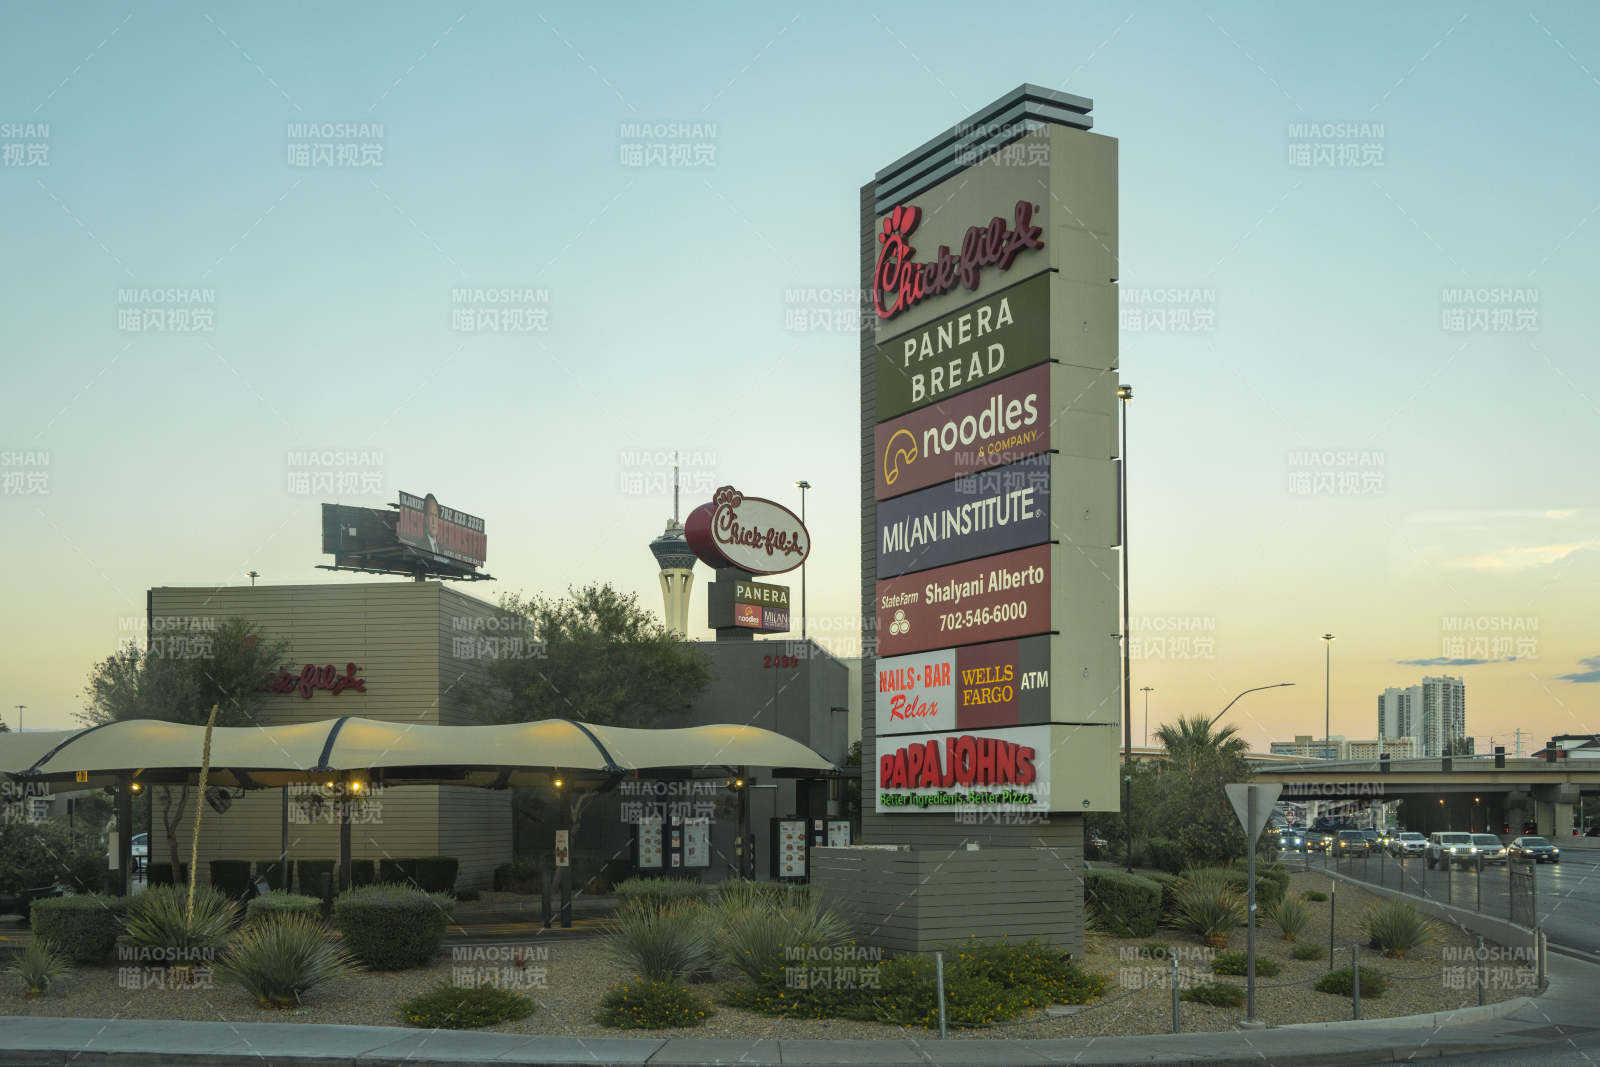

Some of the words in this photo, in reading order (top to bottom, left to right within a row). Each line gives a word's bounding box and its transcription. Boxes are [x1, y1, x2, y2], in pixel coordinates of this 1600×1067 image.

[873, 201, 1045, 318] Chick-fil-A
[904, 298, 1014, 367] PANERA
[911, 342, 1005, 403] BREAD
[923, 393, 1038, 458] noodles
[978, 446, 986, 457] &
[987, 431, 1037, 453] COMPANY
[714, 502, 804, 556] Chick-fil-A
[736, 585, 788, 604] PANERA
[925, 574, 984, 605] Shalyani
[988, 565, 1044, 593] Alberto
[940, 600, 1027, 632] 702-546-6000
[879, 666, 915, 693] NAILS
[924, 662, 951, 689] BAR
[961, 664, 1014, 686] WELLS
[1020, 671, 1048, 690] ATM
[889, 694, 939, 722] Relax
[962, 685, 1014, 706] FARGO
[879, 740, 942, 788] PAPA
[880, 792, 907, 806] Better
[968, 790, 999, 805] Better
[1002, 788, 1033, 804] Pizza.
